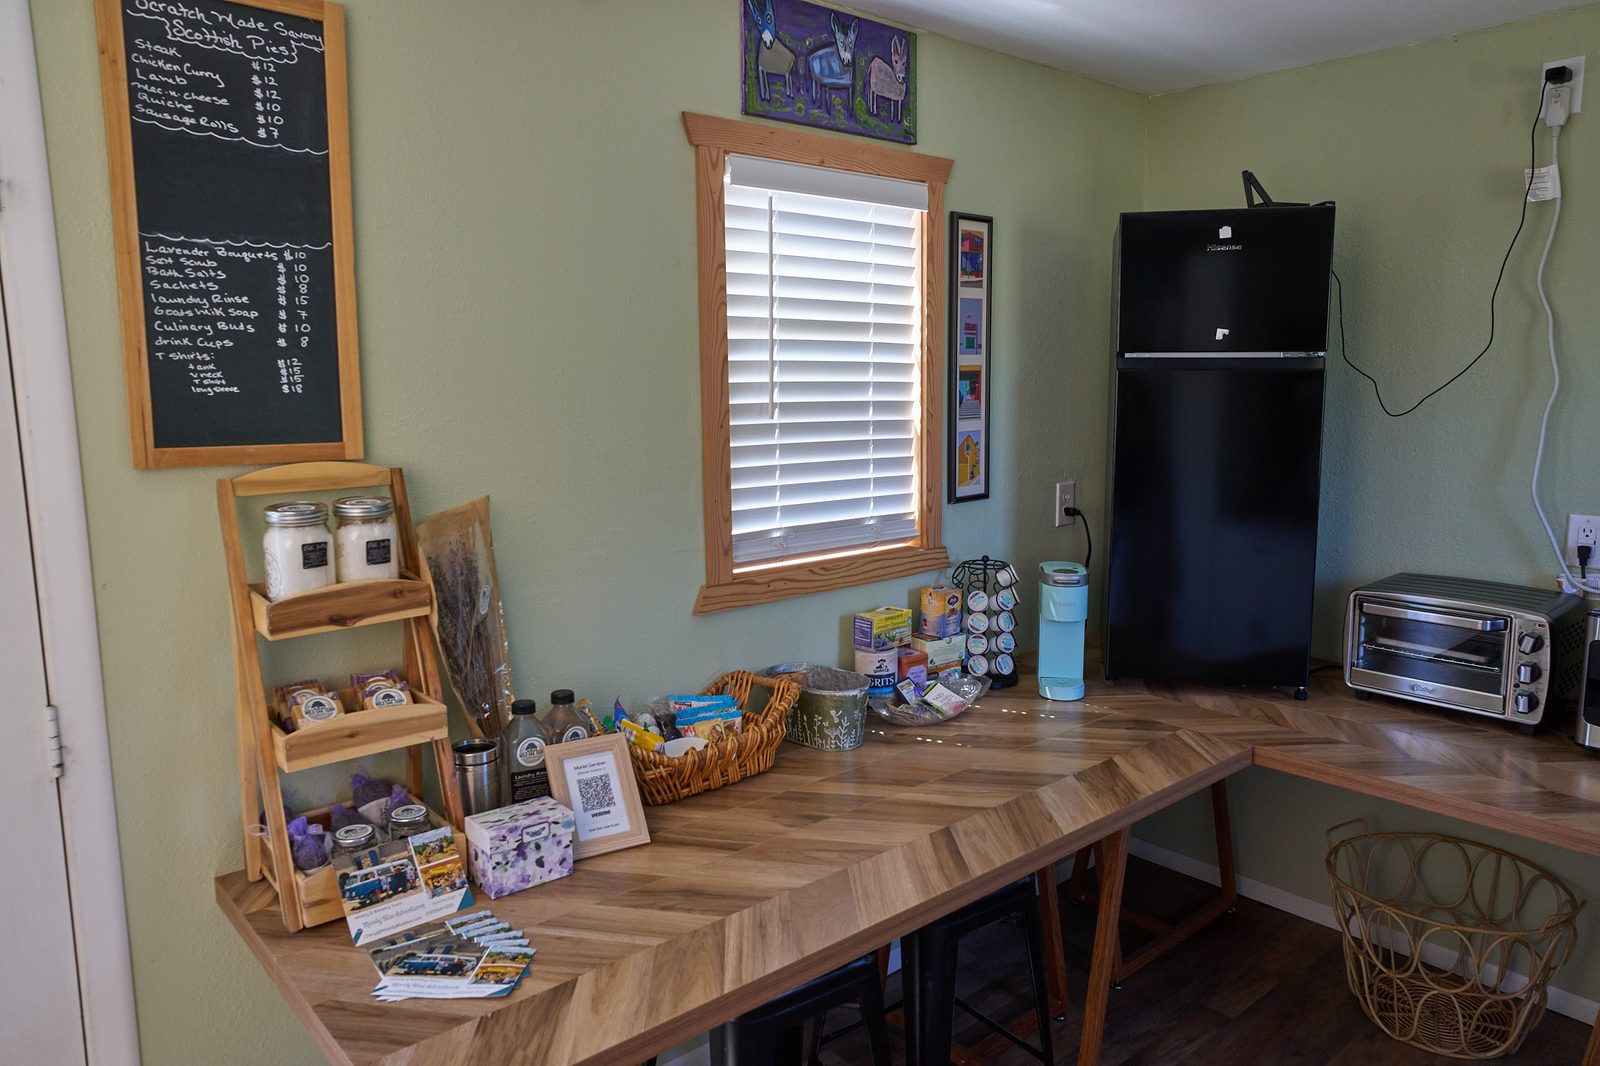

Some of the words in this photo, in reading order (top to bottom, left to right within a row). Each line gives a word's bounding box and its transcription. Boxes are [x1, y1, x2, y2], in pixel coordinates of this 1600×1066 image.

[172, 19, 243, 48] Scottish
[246, 35, 290, 56] Pies
[210, 10, 269, 31] Made
[273, 21, 325, 51] Savory
[135, 67, 188, 85] Lamb
[183, 62, 226, 88] Curry
[137, 92, 195, 113] Quiche
[134, 103, 198, 126] Sausage
[199, 116, 240, 133] Rolls
[145, 240, 210, 257] Lavender
[214, 246, 279, 263] Bouquets
[179, 257, 218, 267] Scrub
[145, 266, 184, 278] Bath
[184, 268, 227, 280] Salts
[149, 279, 219, 291] Sachets
[211, 292, 250, 304] Rinse
[154, 320, 214, 336] Culinary
[216, 321, 256, 333] Buds
[196, 337, 234, 350] Cups
[869, 676, 895, 688] GRITS
